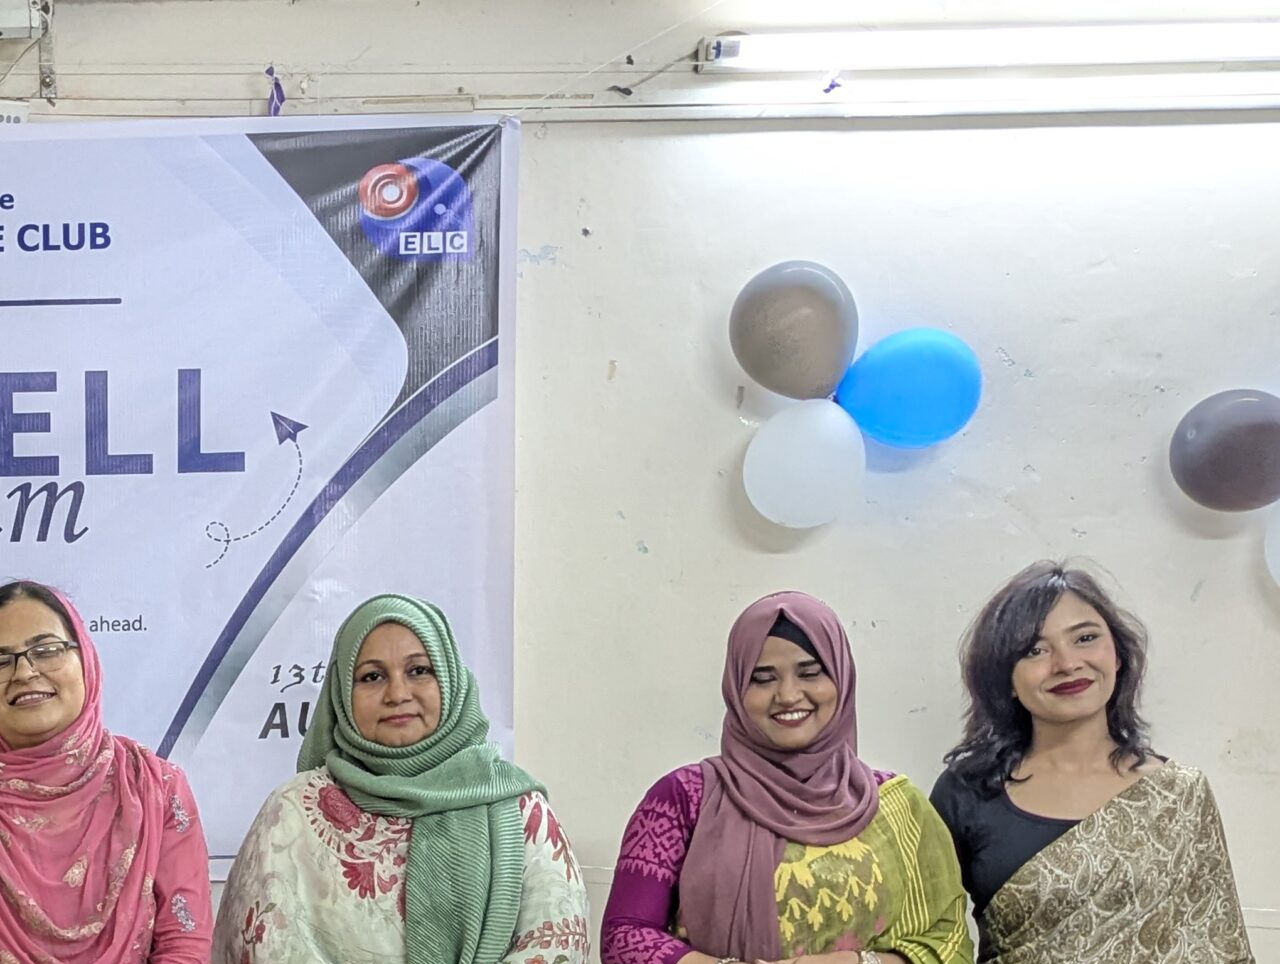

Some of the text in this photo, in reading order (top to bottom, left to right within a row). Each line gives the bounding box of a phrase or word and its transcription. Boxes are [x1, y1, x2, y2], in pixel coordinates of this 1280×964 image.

[16, 222, 111, 252] CLUB
[403, 232, 465, 252] ELC
[89, 614, 148, 633] ahead.
[270, 660, 326, 693] 13t
